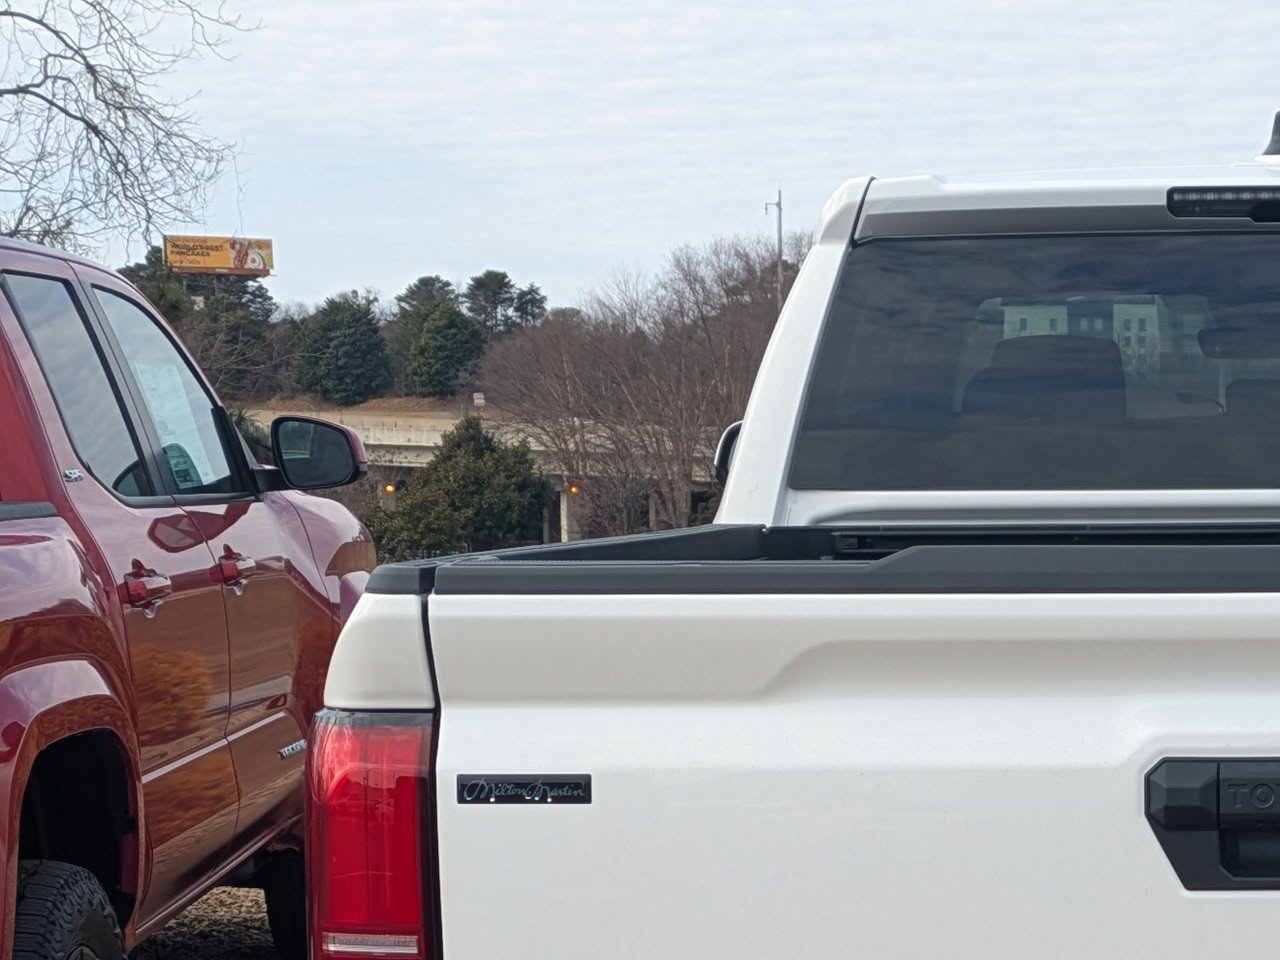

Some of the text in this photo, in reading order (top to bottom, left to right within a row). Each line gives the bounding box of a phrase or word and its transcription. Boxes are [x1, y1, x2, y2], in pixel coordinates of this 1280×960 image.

[170, 243, 224, 252] WORLD'S BEST
[170, 249, 211, 257] PANCAKES
[463, 777, 586, 802] Milton Martin
